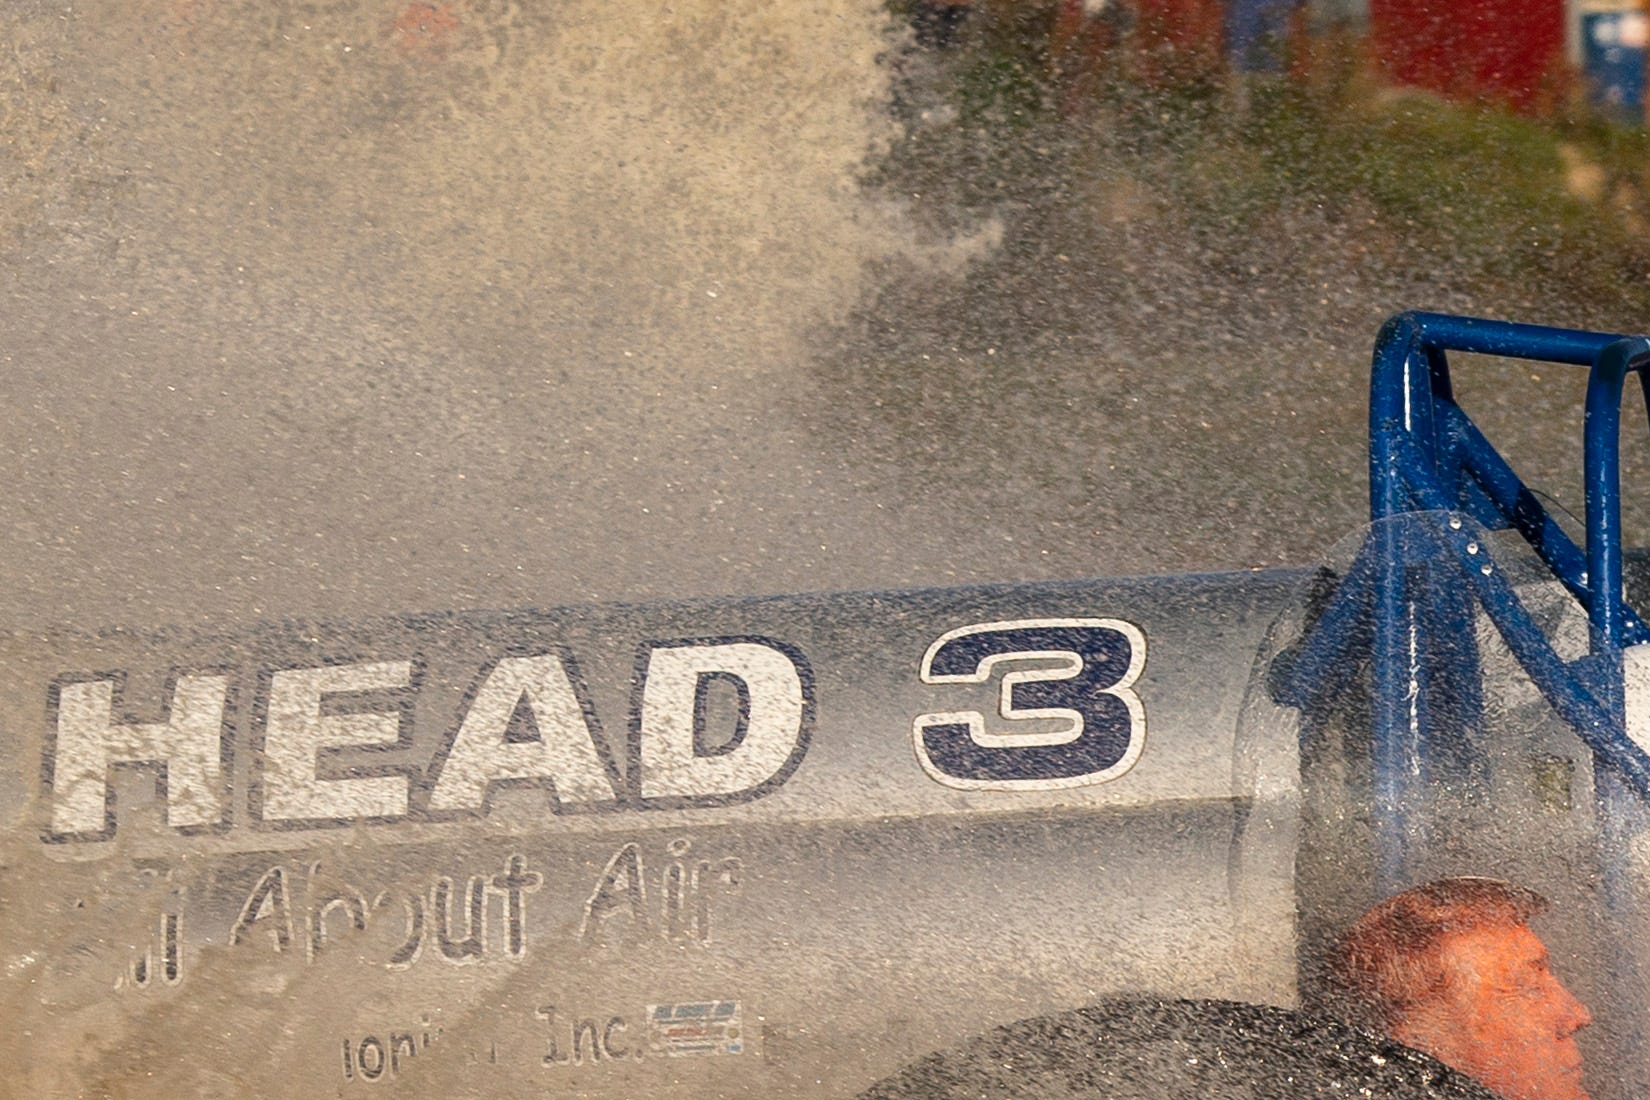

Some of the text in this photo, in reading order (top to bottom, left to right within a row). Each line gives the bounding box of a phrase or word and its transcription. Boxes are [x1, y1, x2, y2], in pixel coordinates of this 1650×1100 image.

[40, 616, 1149, 844] HEAD 3
[538, 1003, 643, 1068] Inc.
